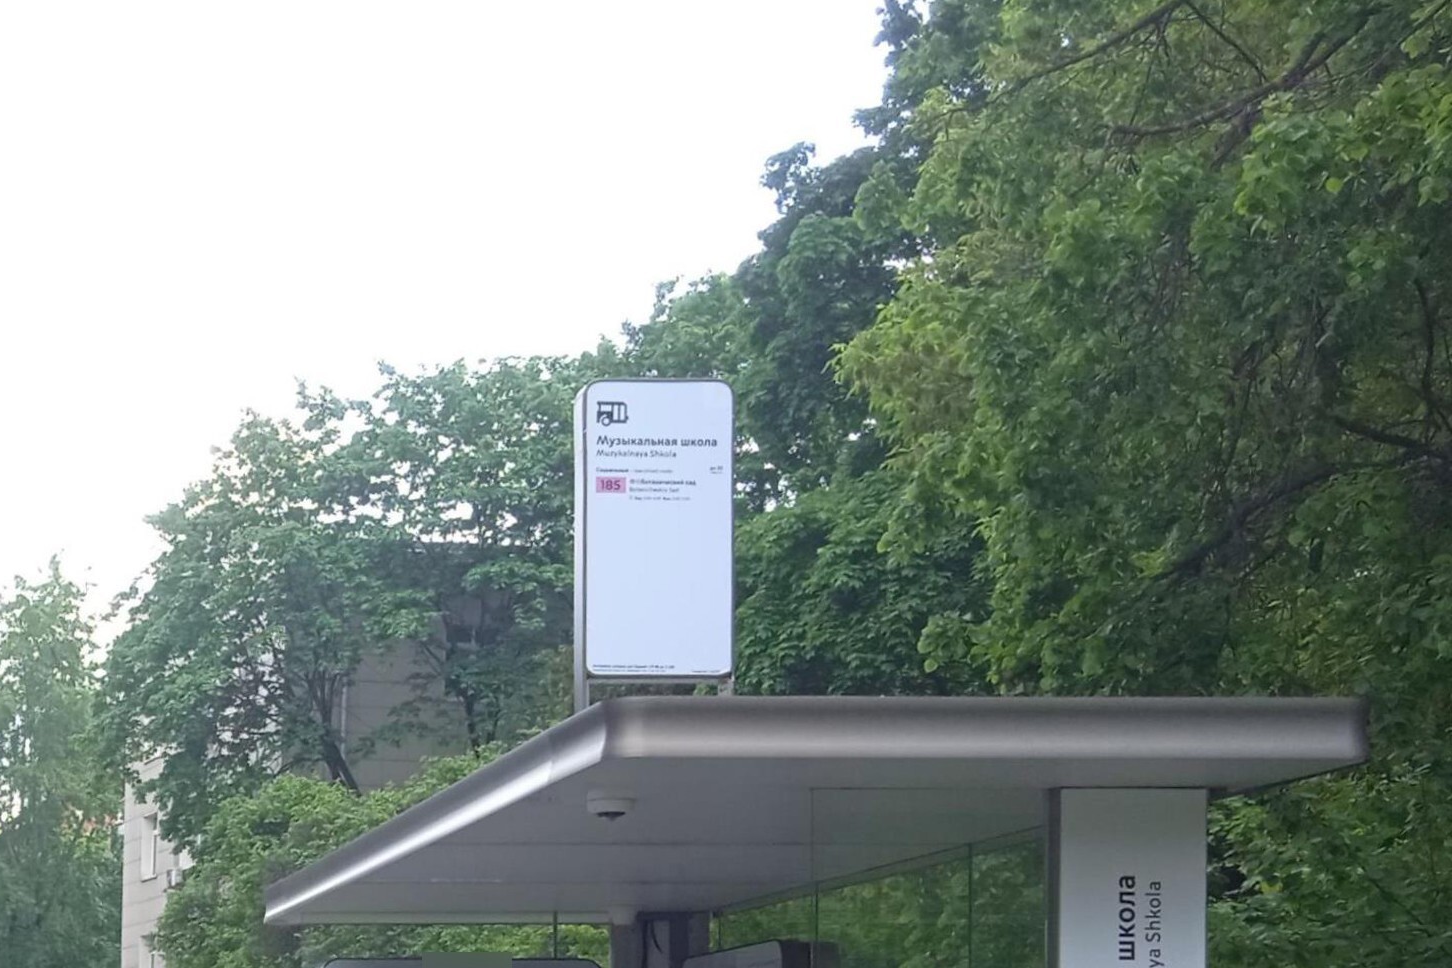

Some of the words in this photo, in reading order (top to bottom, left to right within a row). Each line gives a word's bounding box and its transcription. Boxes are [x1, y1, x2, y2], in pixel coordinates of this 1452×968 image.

[596, 435, 678, 448] Музыкальная
[681, 438, 718, 447] школа
[600, 479, 621, 491] 185
[1118, 874, 1136, 961] школа
[1145, 880, 1162, 943] Shkola
